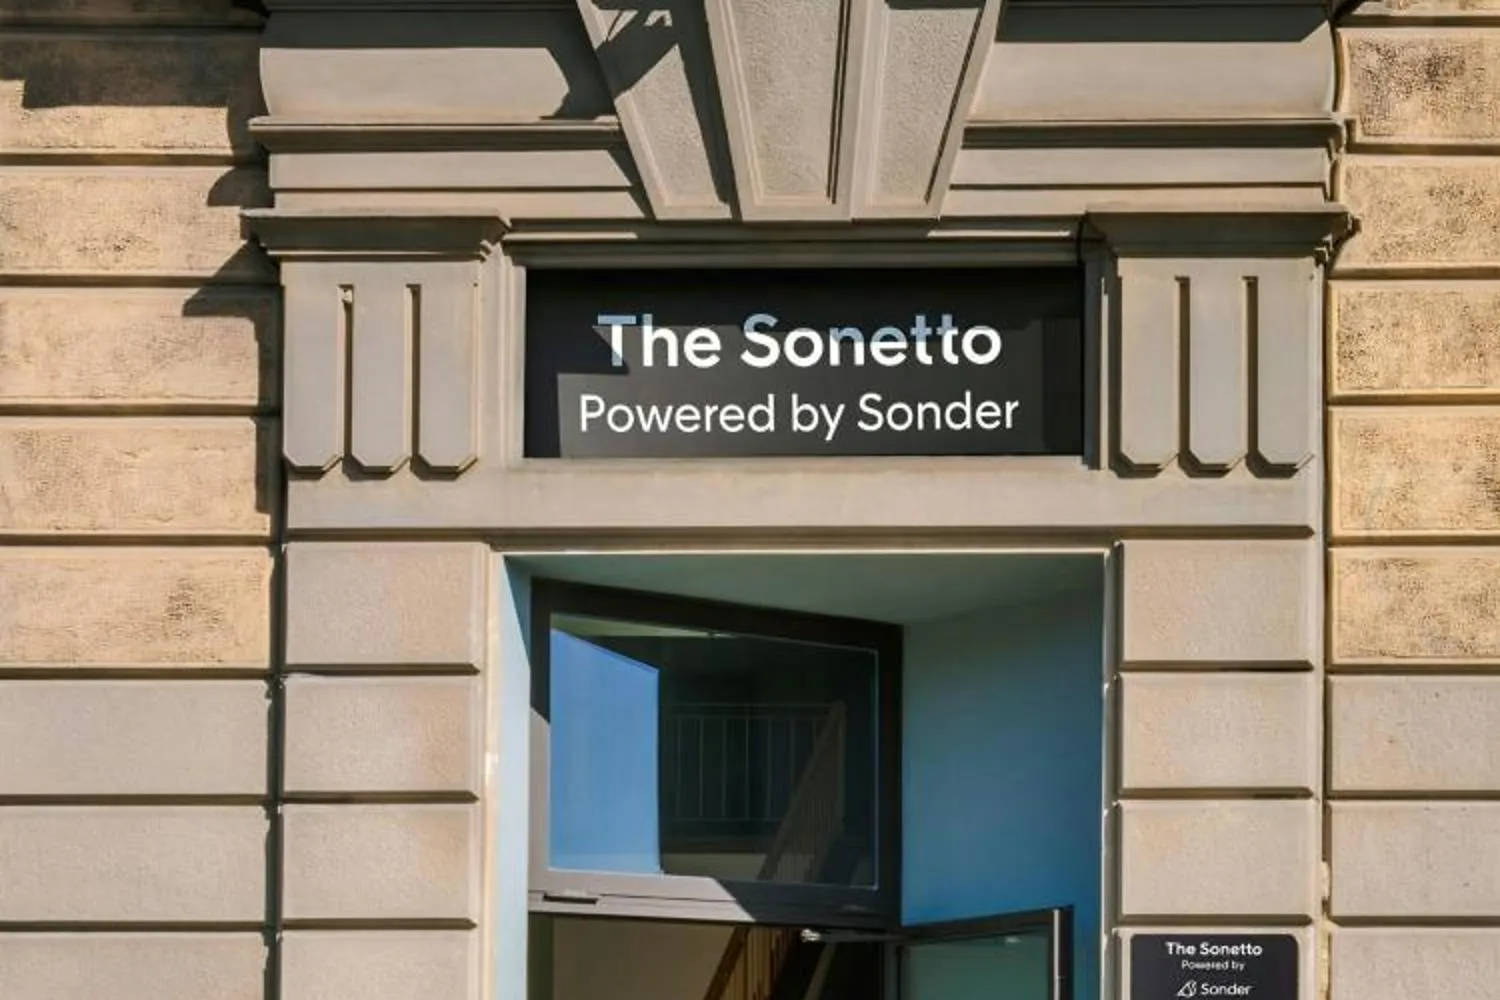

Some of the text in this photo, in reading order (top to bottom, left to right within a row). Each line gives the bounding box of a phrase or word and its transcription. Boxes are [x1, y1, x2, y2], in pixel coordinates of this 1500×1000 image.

[597, 313, 1003, 369] The Sonetto
[580, 390, 1019, 441] Powered by Sonder
[1165, 941, 1263, 956] The Sonetto
[1181, 959, 1245, 971] Powered by
[1200, 983, 1252, 996] Sonder
